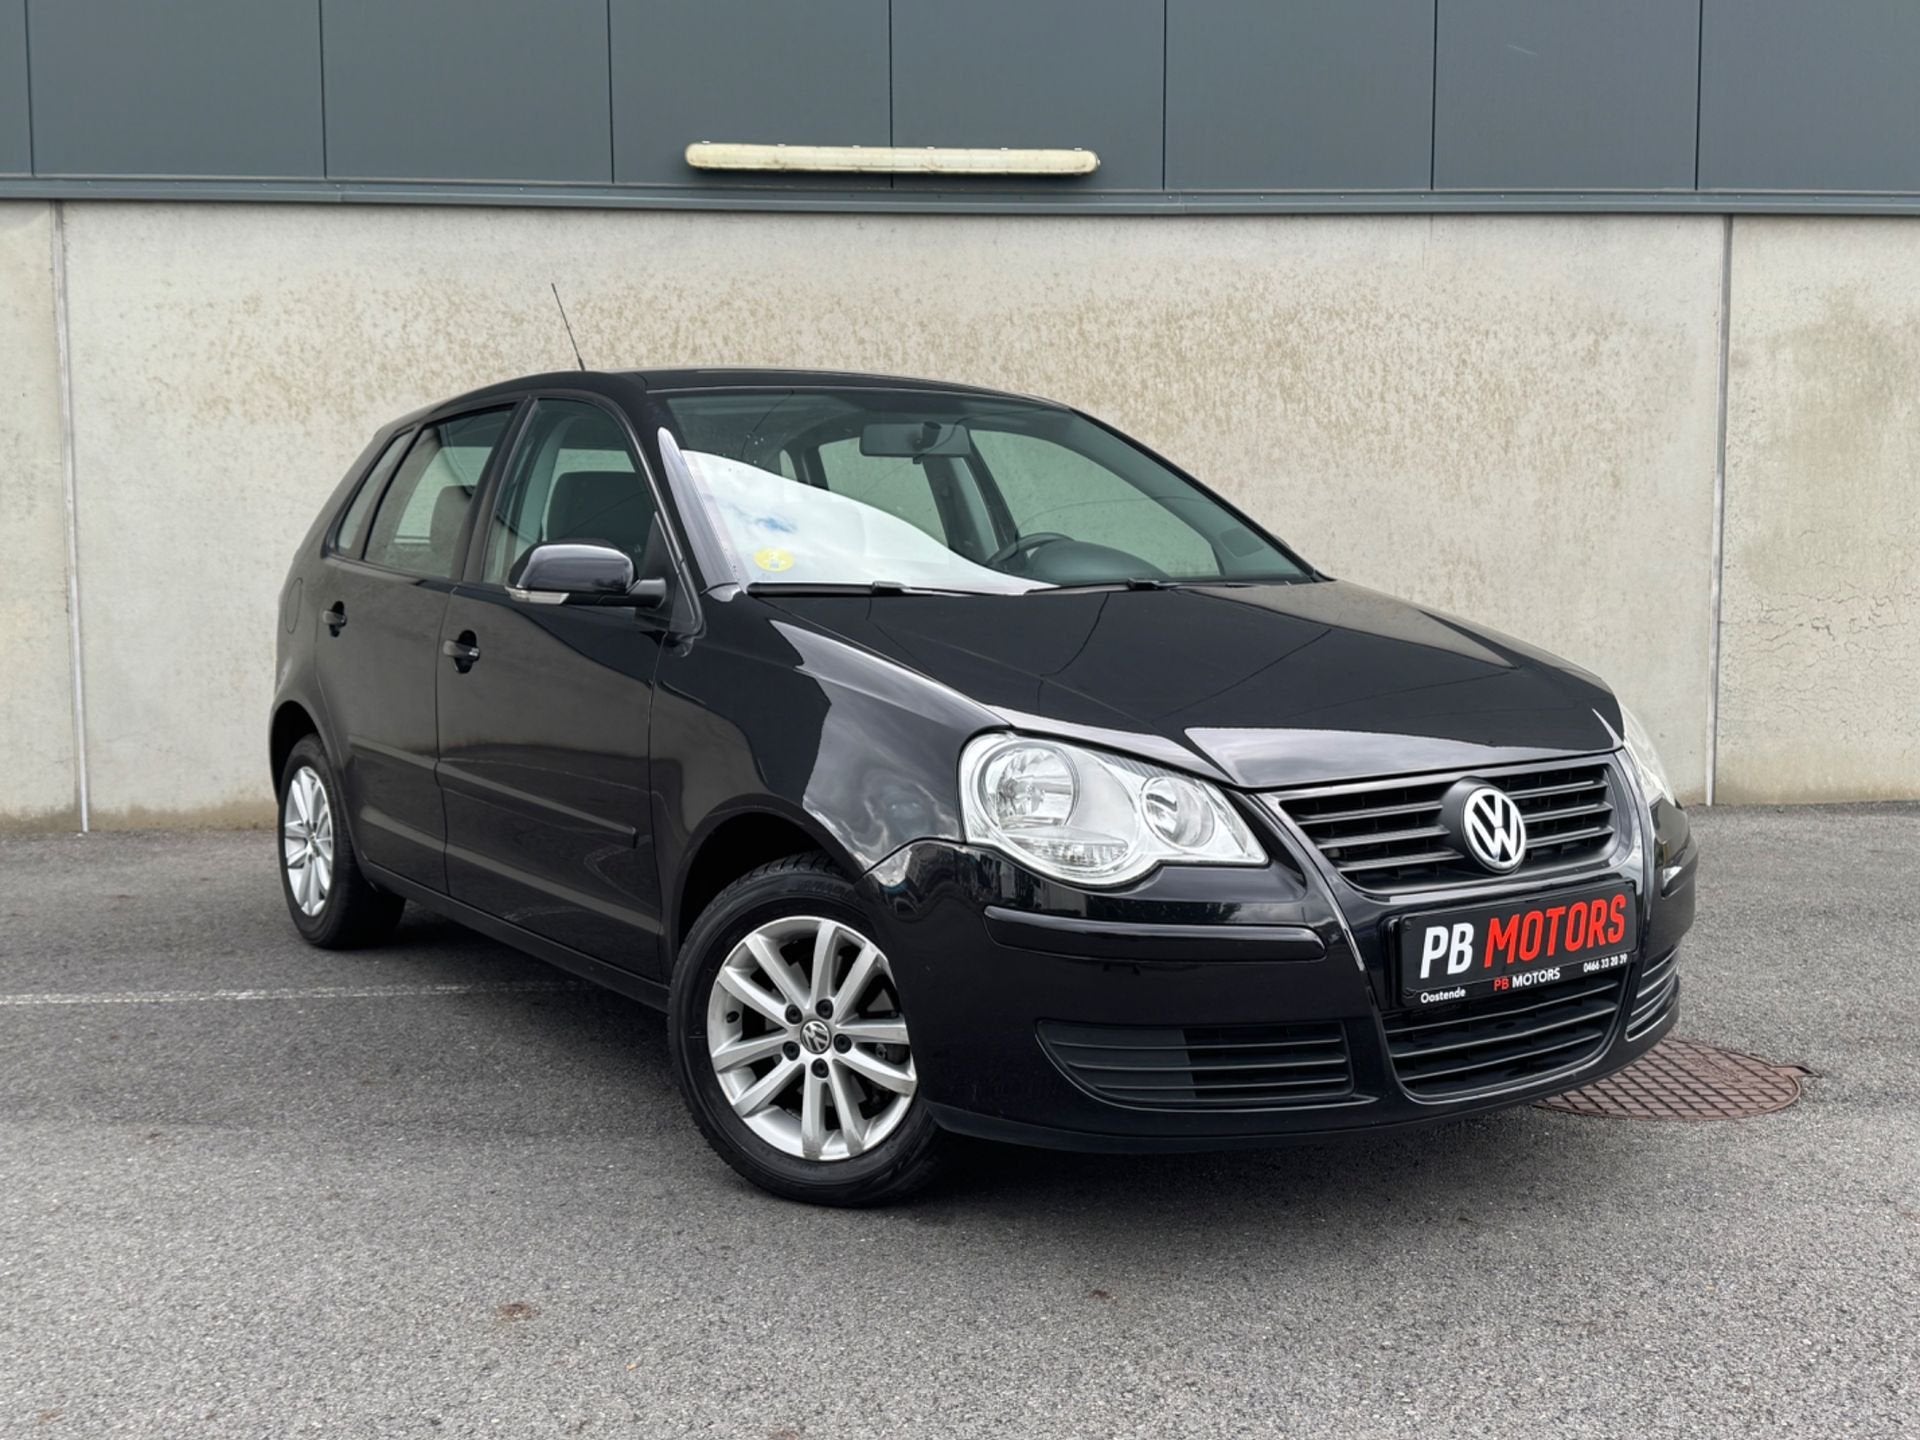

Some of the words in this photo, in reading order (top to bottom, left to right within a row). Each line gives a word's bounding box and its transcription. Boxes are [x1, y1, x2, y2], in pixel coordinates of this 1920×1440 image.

[1464, 787, 1526, 870] VW
[1420, 922, 1475, 979] PB
[1484, 894, 1627, 968] MOTORS
[1420, 987, 1466, 1004] Oostende
[1494, 976, 1510, 992] PB
[1512, 968, 1561, 988] MOTORS
[802, 1021, 831, 1054] VW
